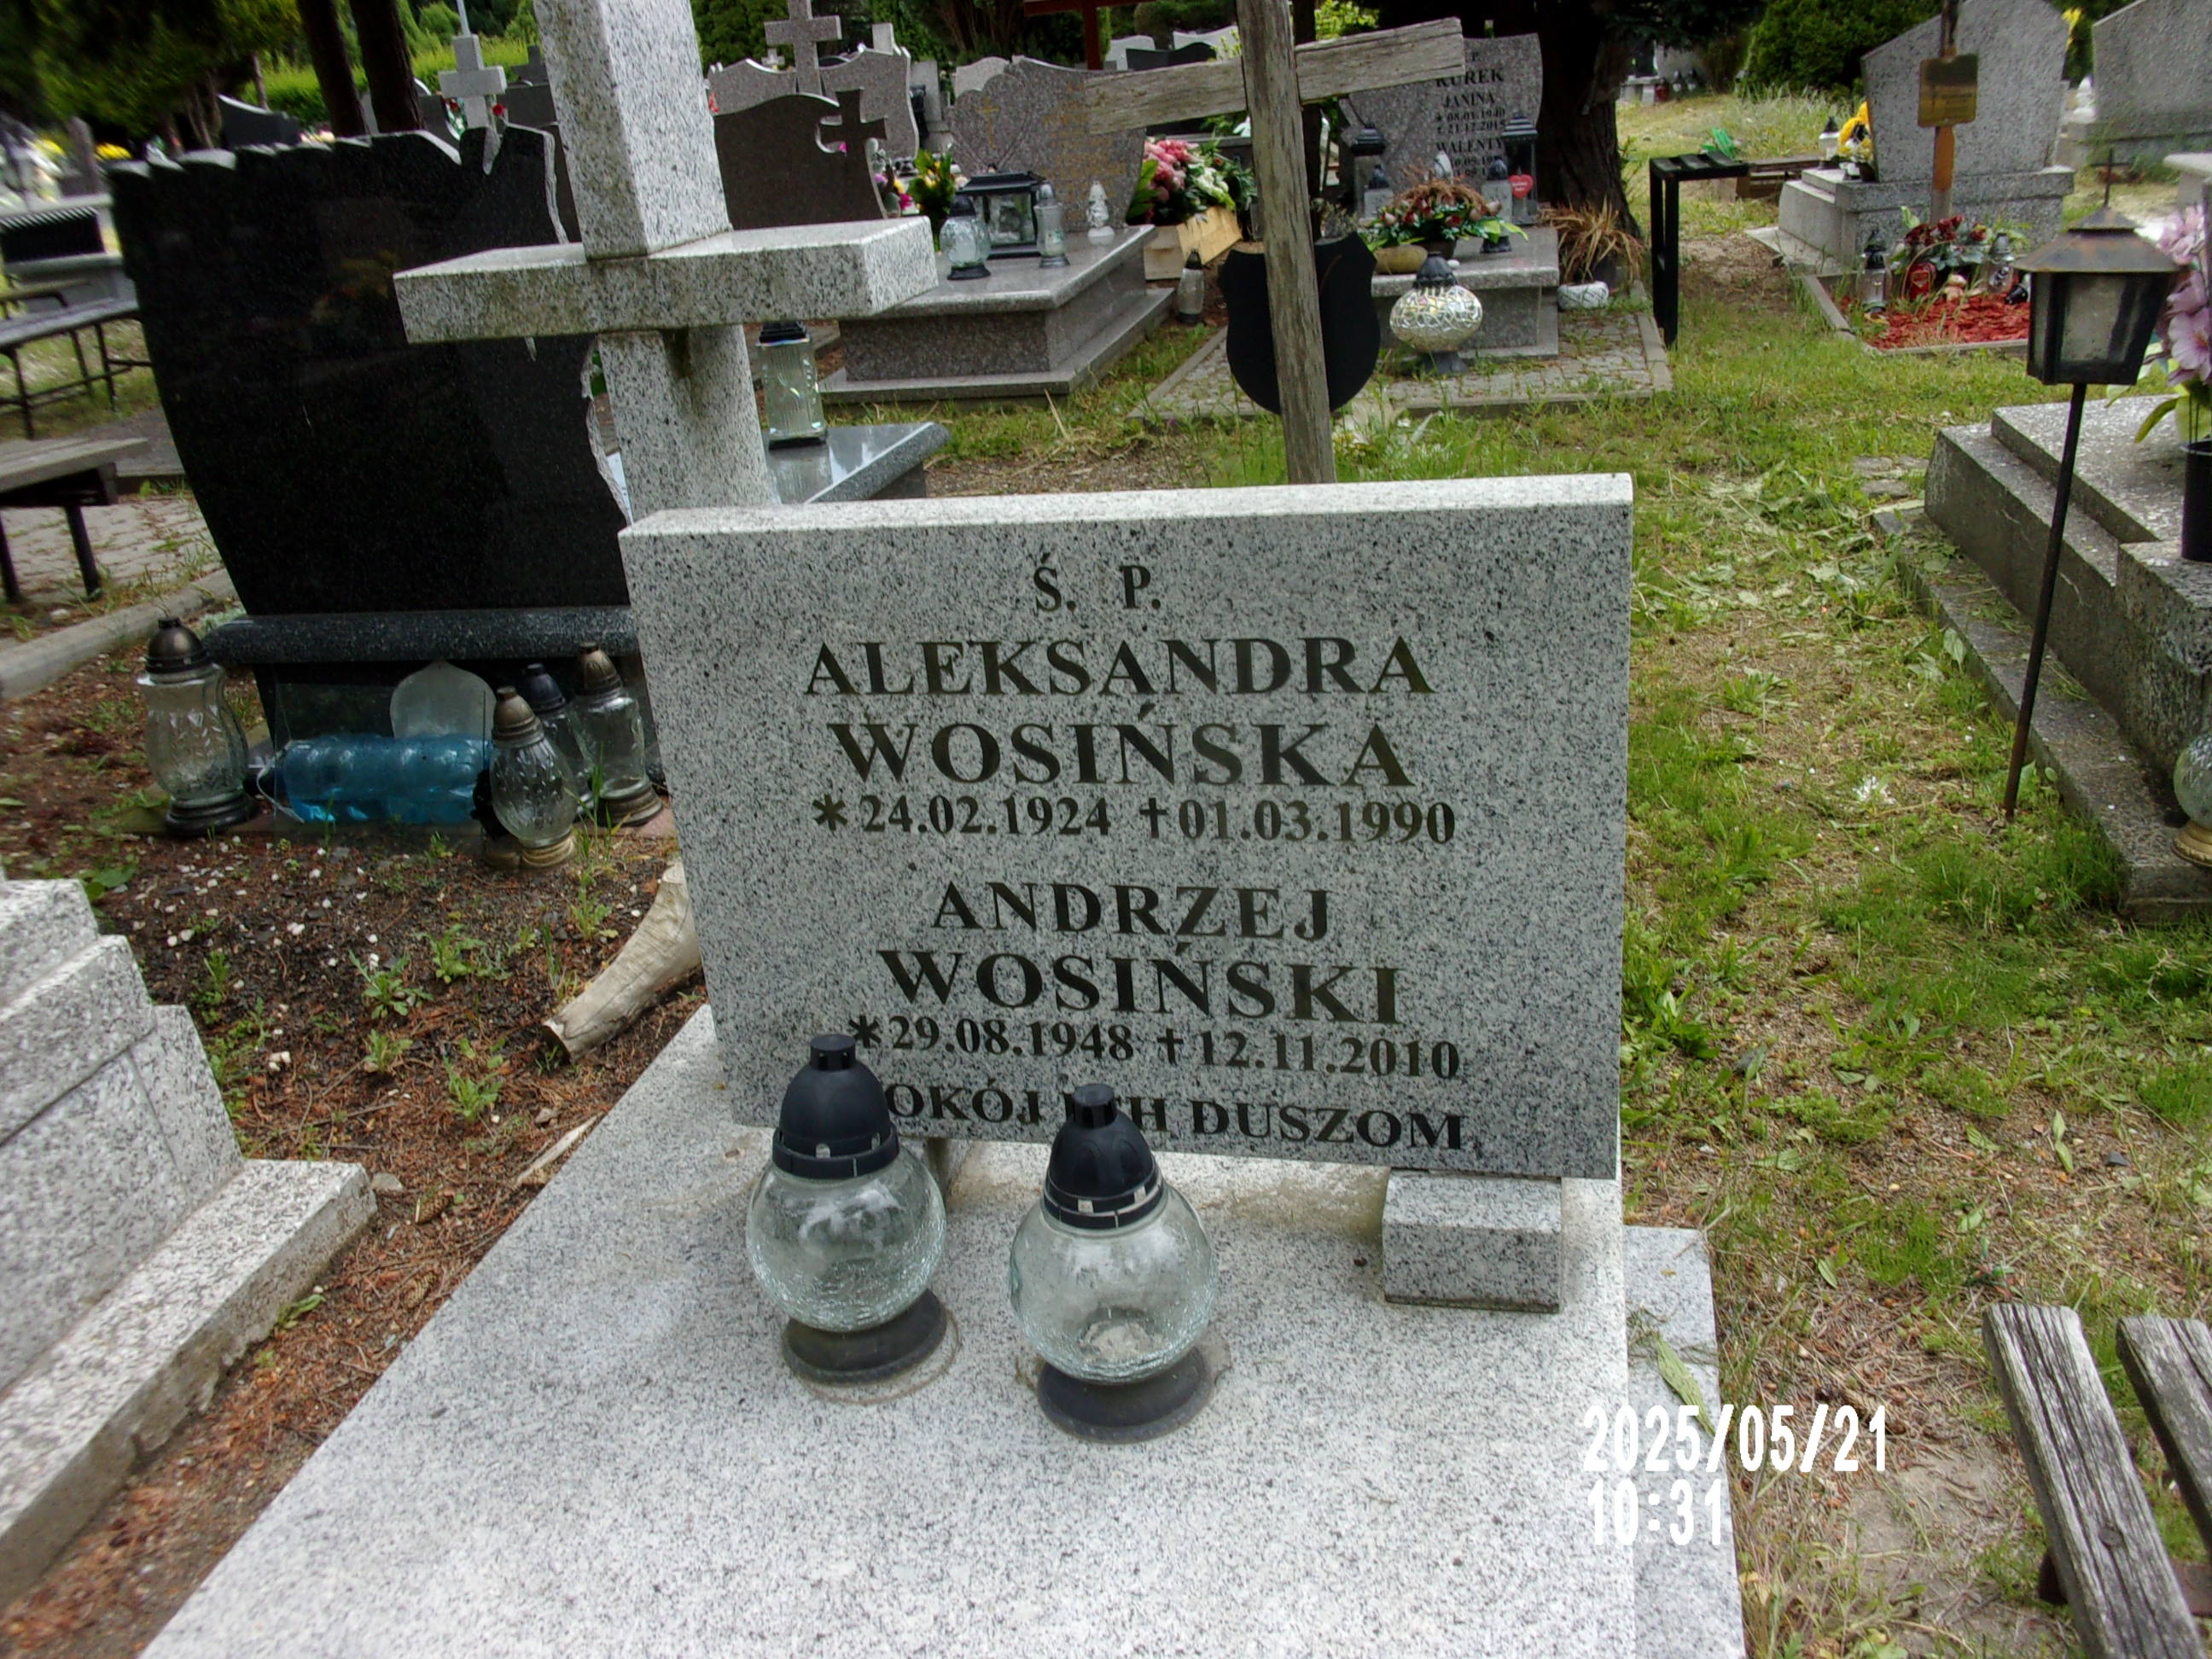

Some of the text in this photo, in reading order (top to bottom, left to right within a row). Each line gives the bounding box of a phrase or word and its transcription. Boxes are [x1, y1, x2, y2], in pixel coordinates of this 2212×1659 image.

[1443, 90, 1496, 108] JANINA
[1122, 563, 1162, 610] P.
[805, 634, 1435, 696] ALEKSANDRA
[827, 704, 1417, 789] WOSIŃSKA
[932, 880, 1331, 942] ANDRZEJ
[876, 943, 1406, 1025] WOSIŃSKI
[882, 1078, 1042, 1125] OKÓJ
[1195, 1100, 1466, 1151] DUSZOM
